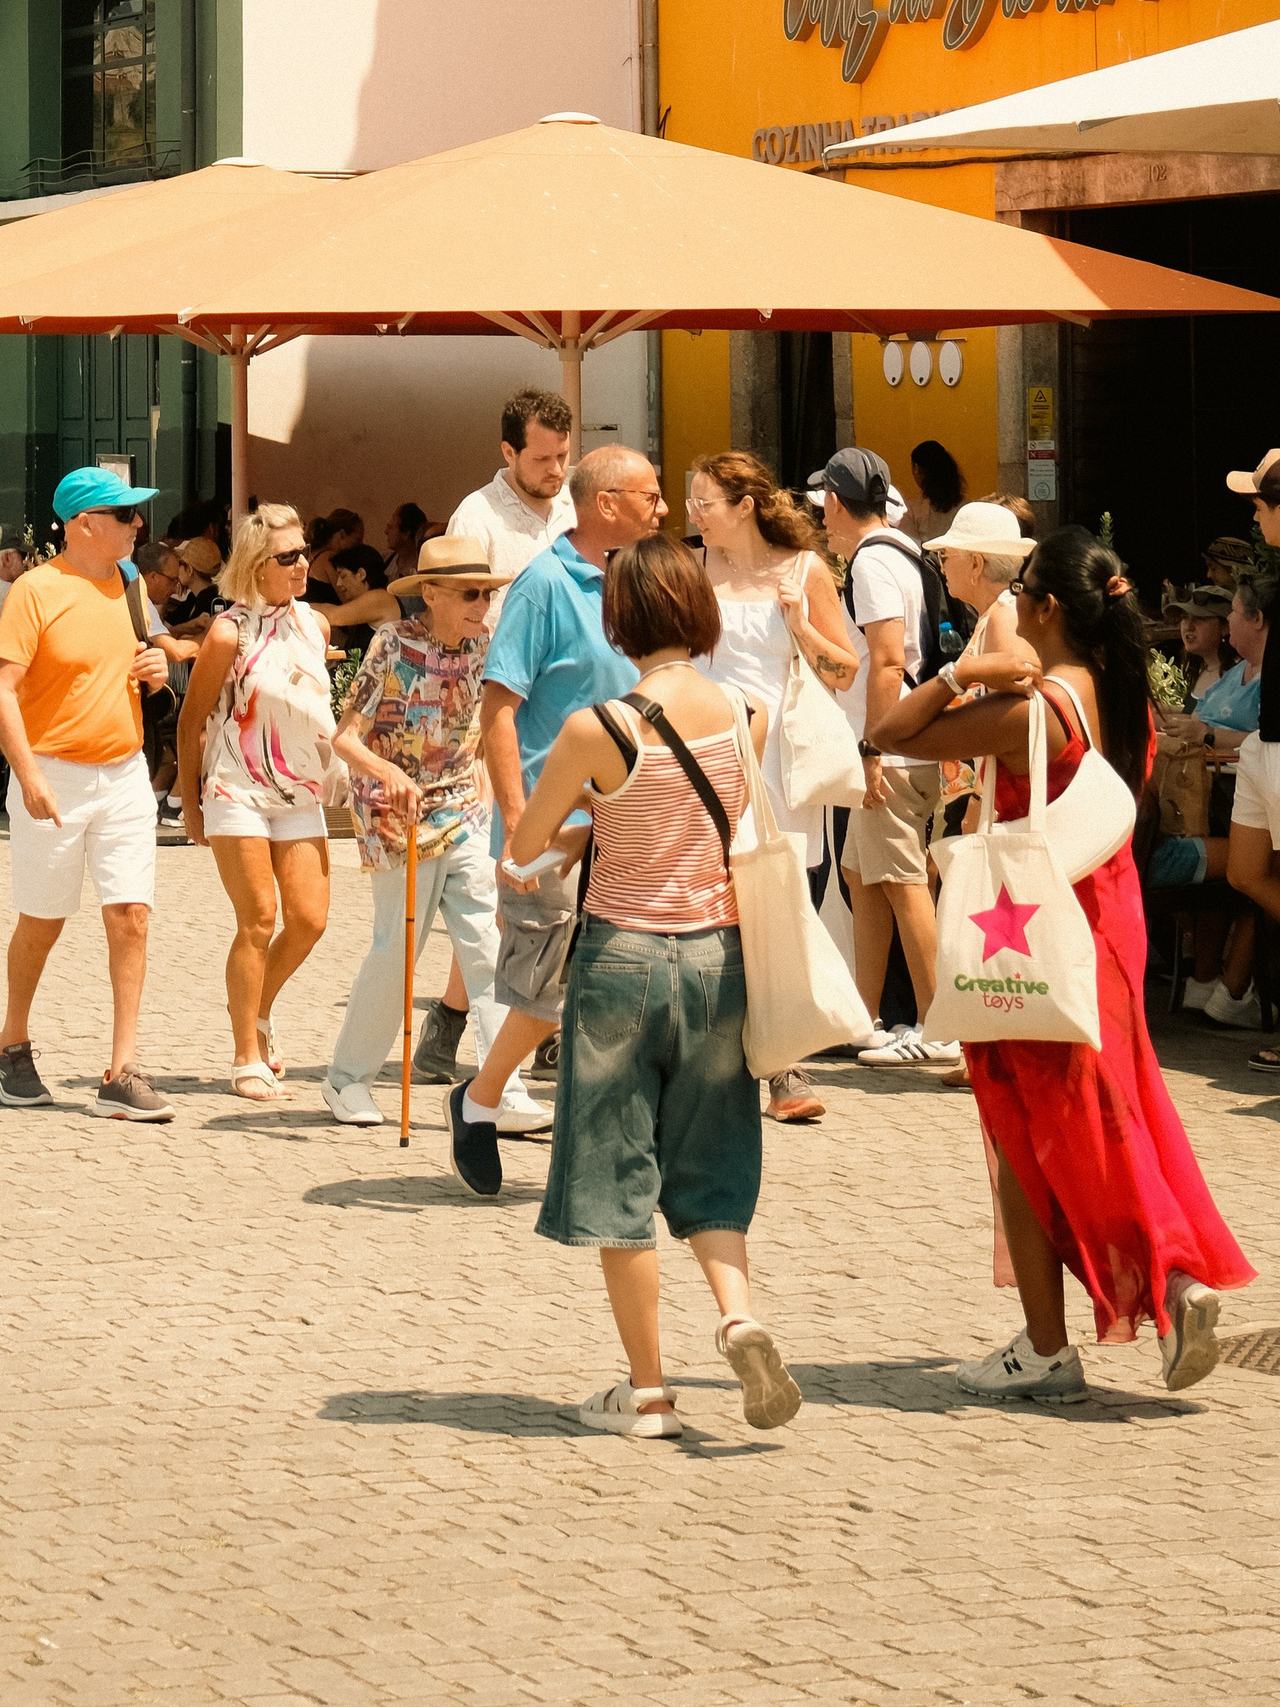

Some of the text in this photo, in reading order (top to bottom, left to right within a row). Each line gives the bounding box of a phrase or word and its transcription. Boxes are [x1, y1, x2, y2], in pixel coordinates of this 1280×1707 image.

[1147, 164, 1167, 182] 102
[954, 974, 1049, 995] Creative
[982, 992, 1024, 1013] toys
